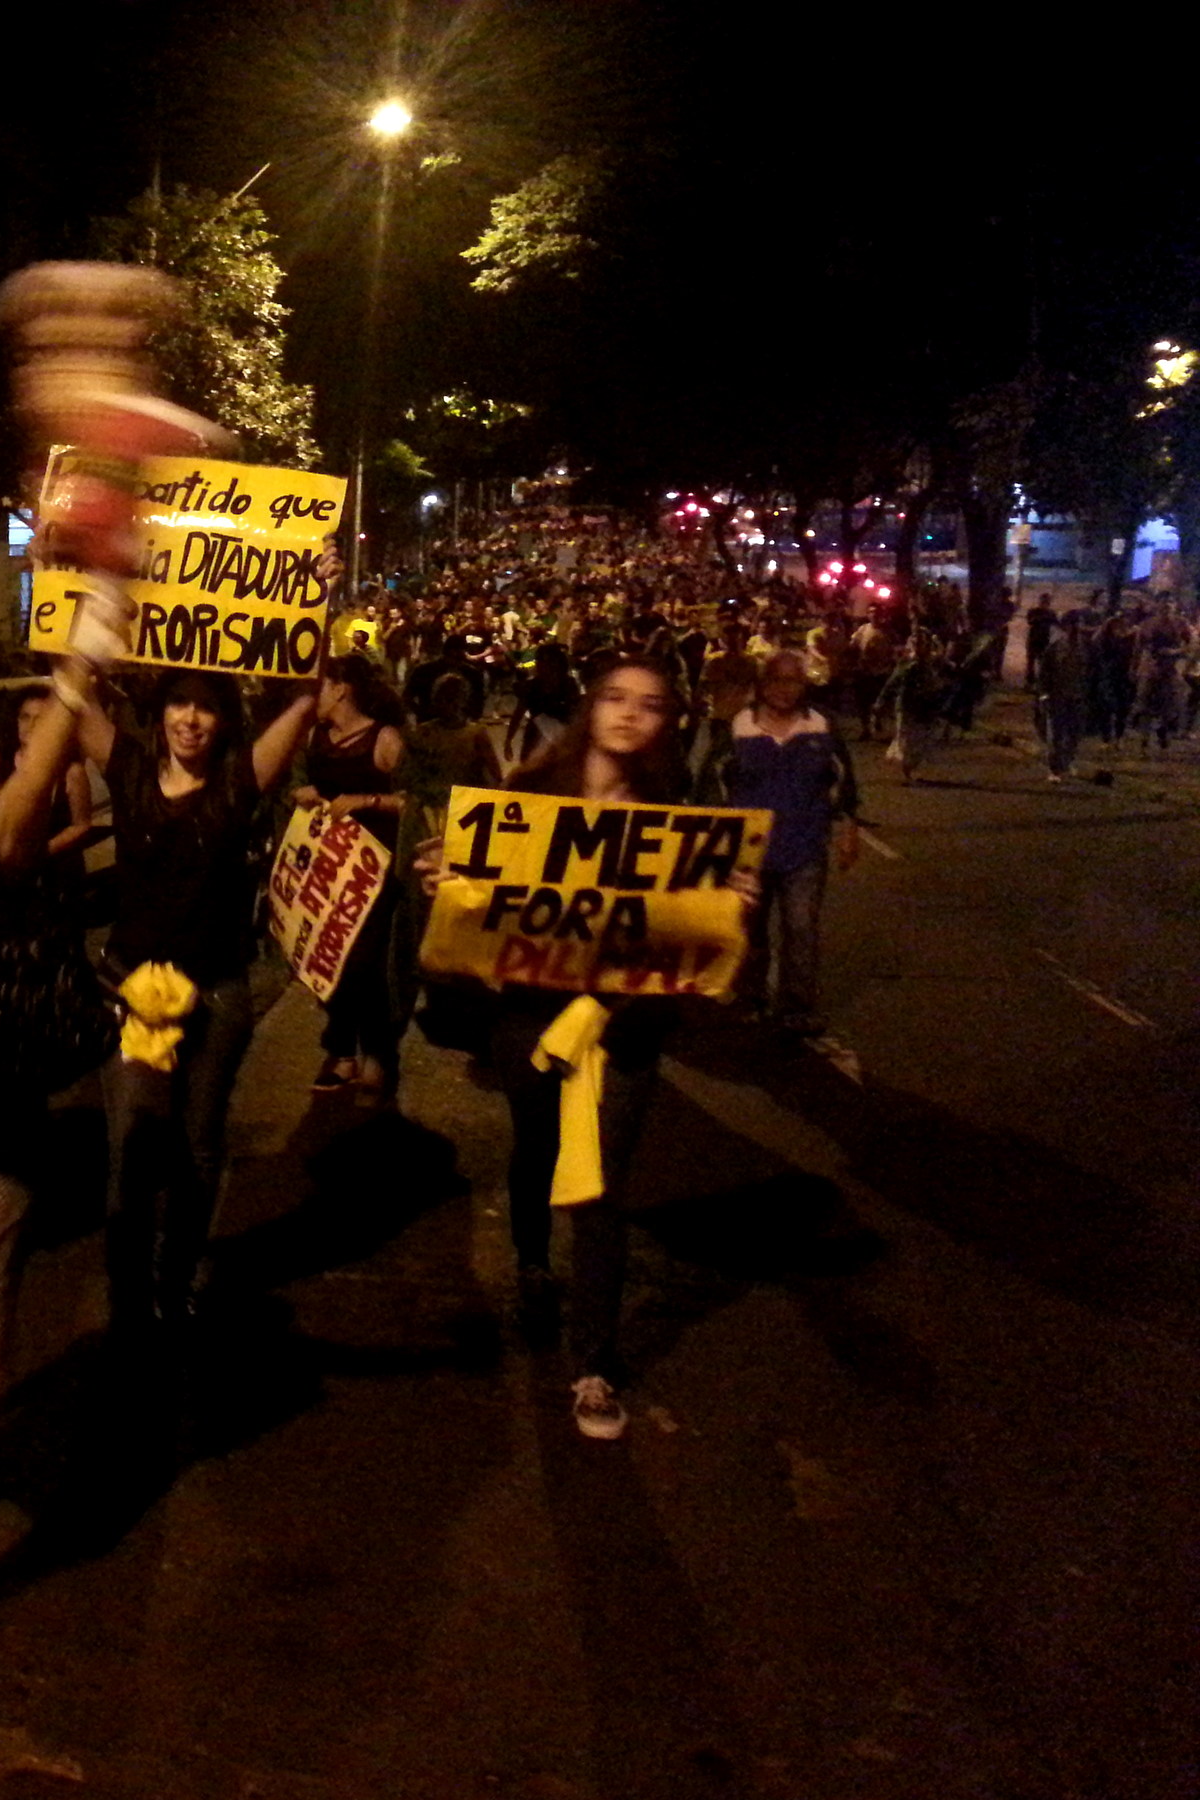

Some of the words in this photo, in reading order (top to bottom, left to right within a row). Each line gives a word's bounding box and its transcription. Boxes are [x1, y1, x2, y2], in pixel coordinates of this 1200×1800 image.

[269, 492, 337, 529] que
[178, 531, 329, 609] DITADURAS
[35, 601, 56, 633] e
[482, 884, 649, 943] FORA
